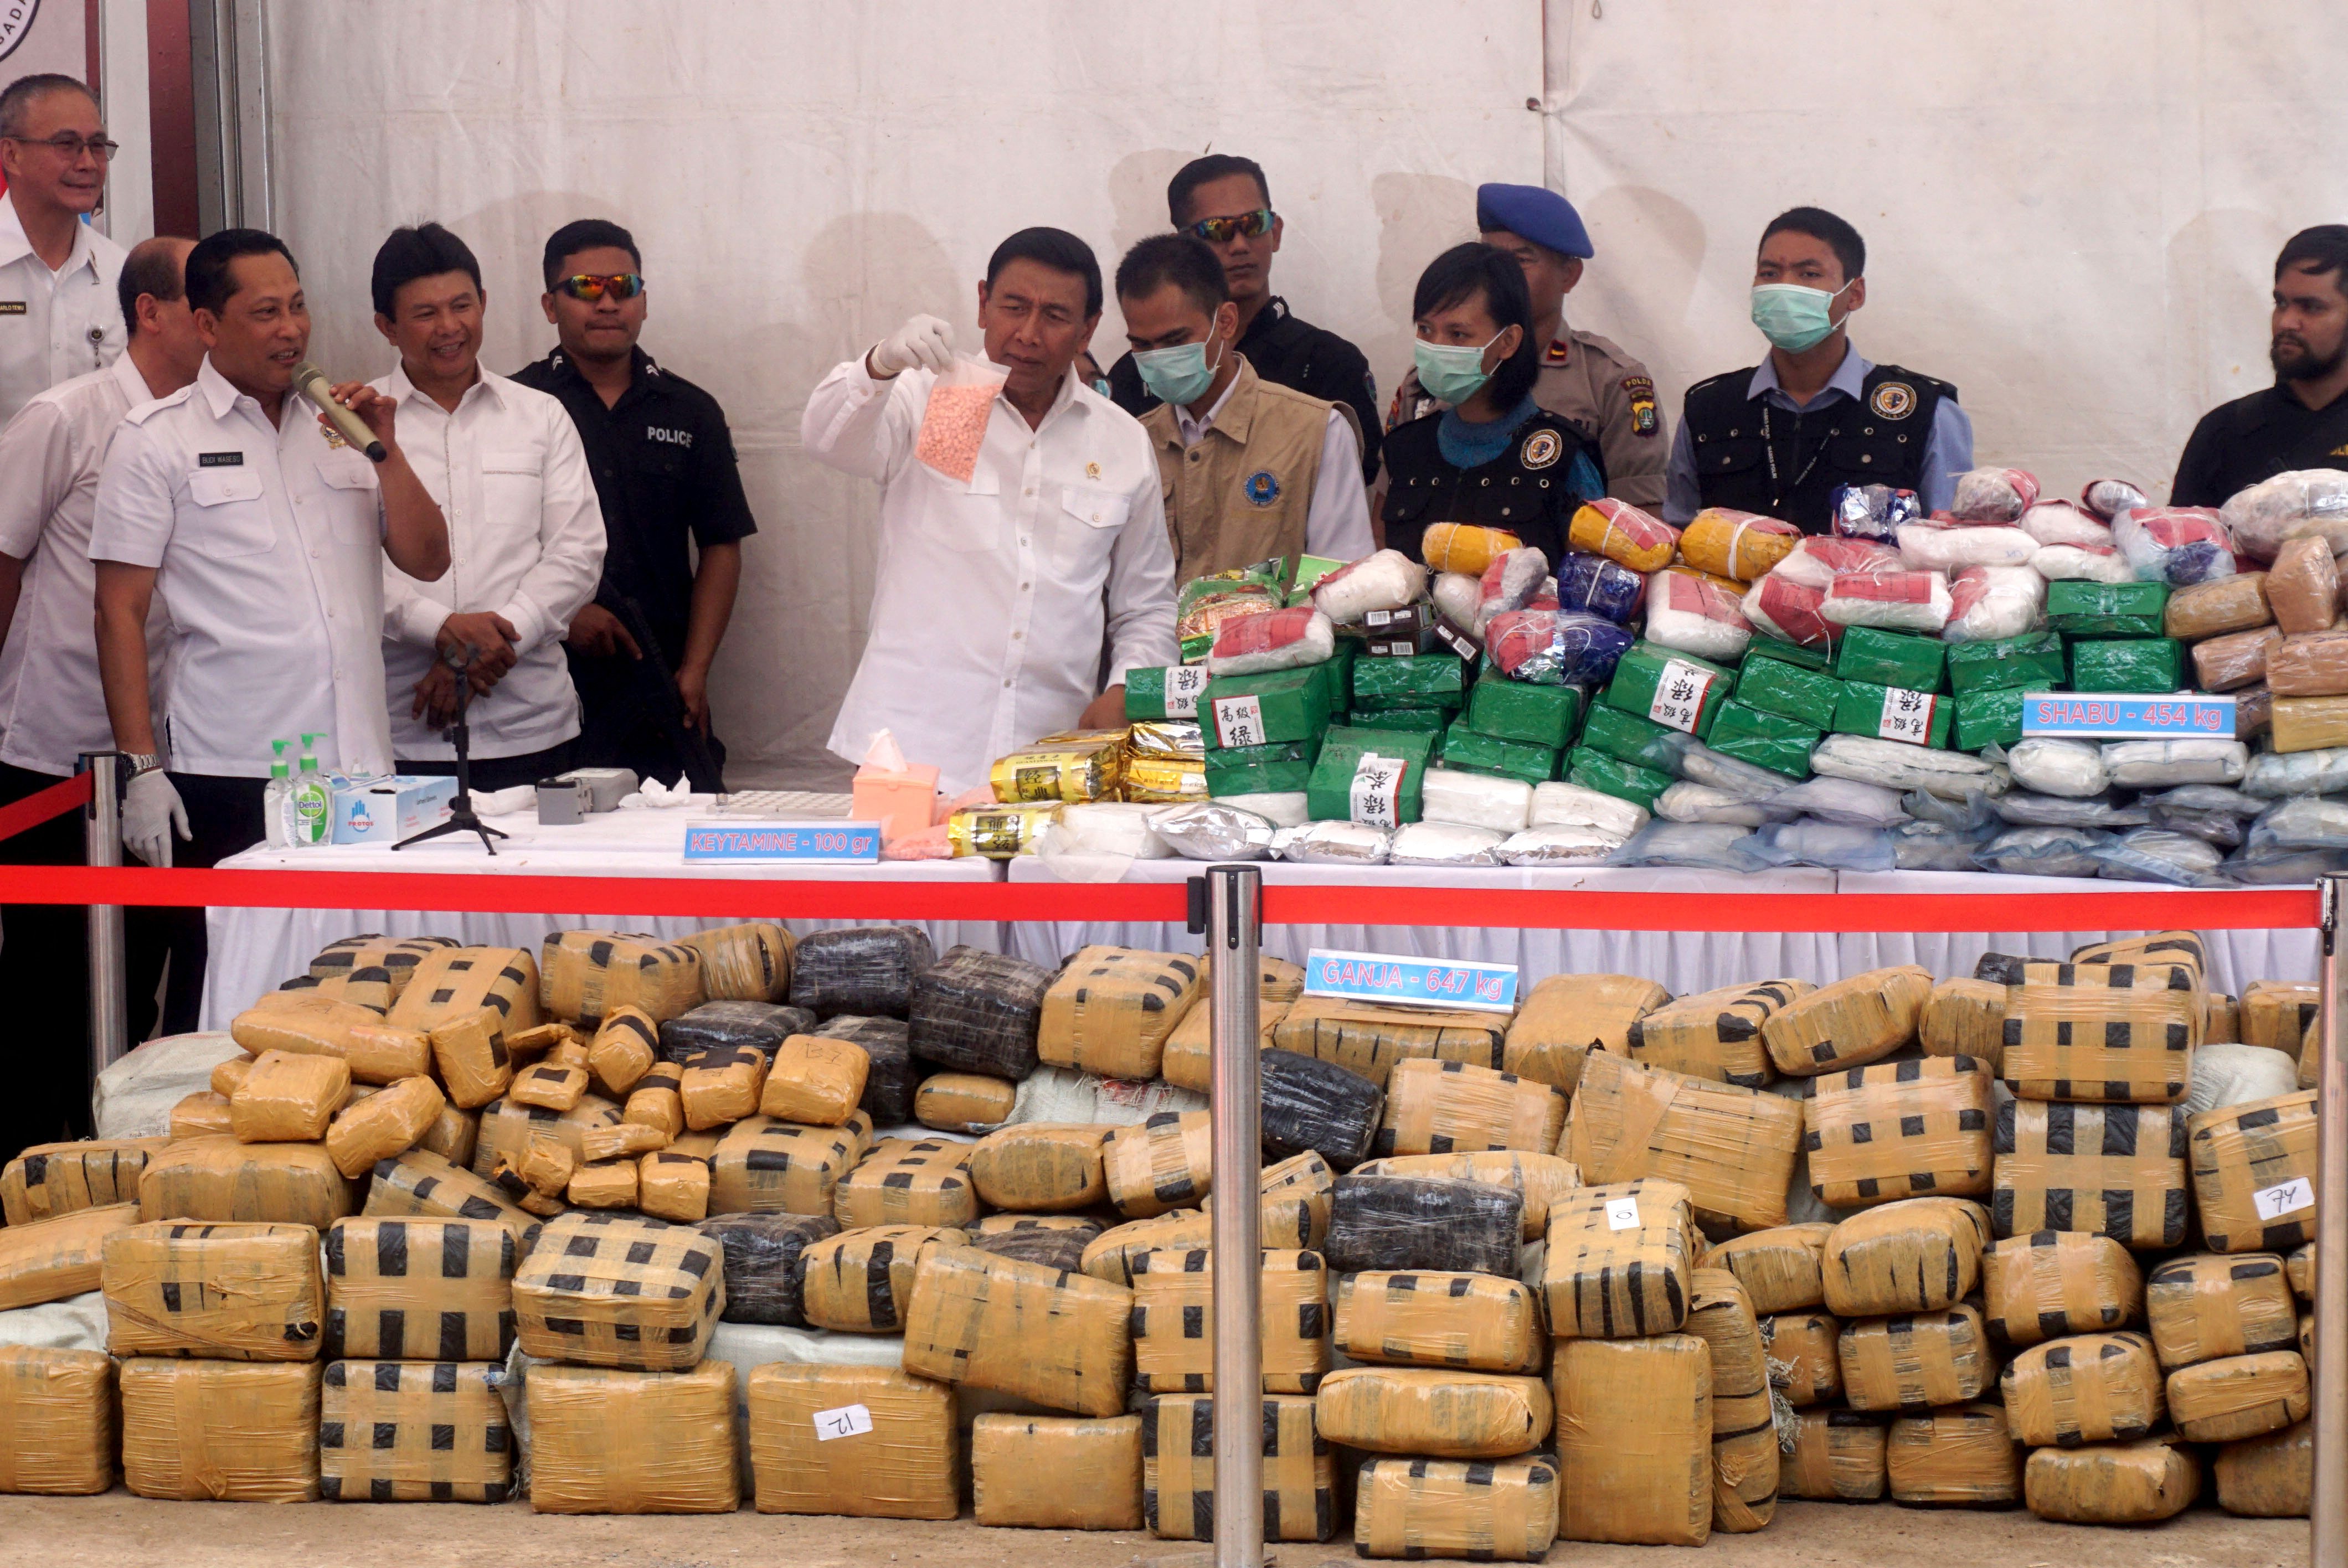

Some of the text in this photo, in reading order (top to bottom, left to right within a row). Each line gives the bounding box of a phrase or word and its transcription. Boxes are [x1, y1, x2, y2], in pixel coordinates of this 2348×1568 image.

[647, 426, 693, 448] POLICE
[1220, 705, 1252, 723] 高级
[2038, 702, 2120, 725] SHABU
[2143, 704, 2187, 726] 454
[2194, 704, 2222, 730] kg
[691, 833, 797, 851] KEYTAMINE
[815, 833, 847, 851] 100
[852, 836, 872, 855] gr
[1322, 960, 1403, 989] GANJA
[1426, 968, 1470, 993] 647
[1475, 971, 1503, 1002] kg
